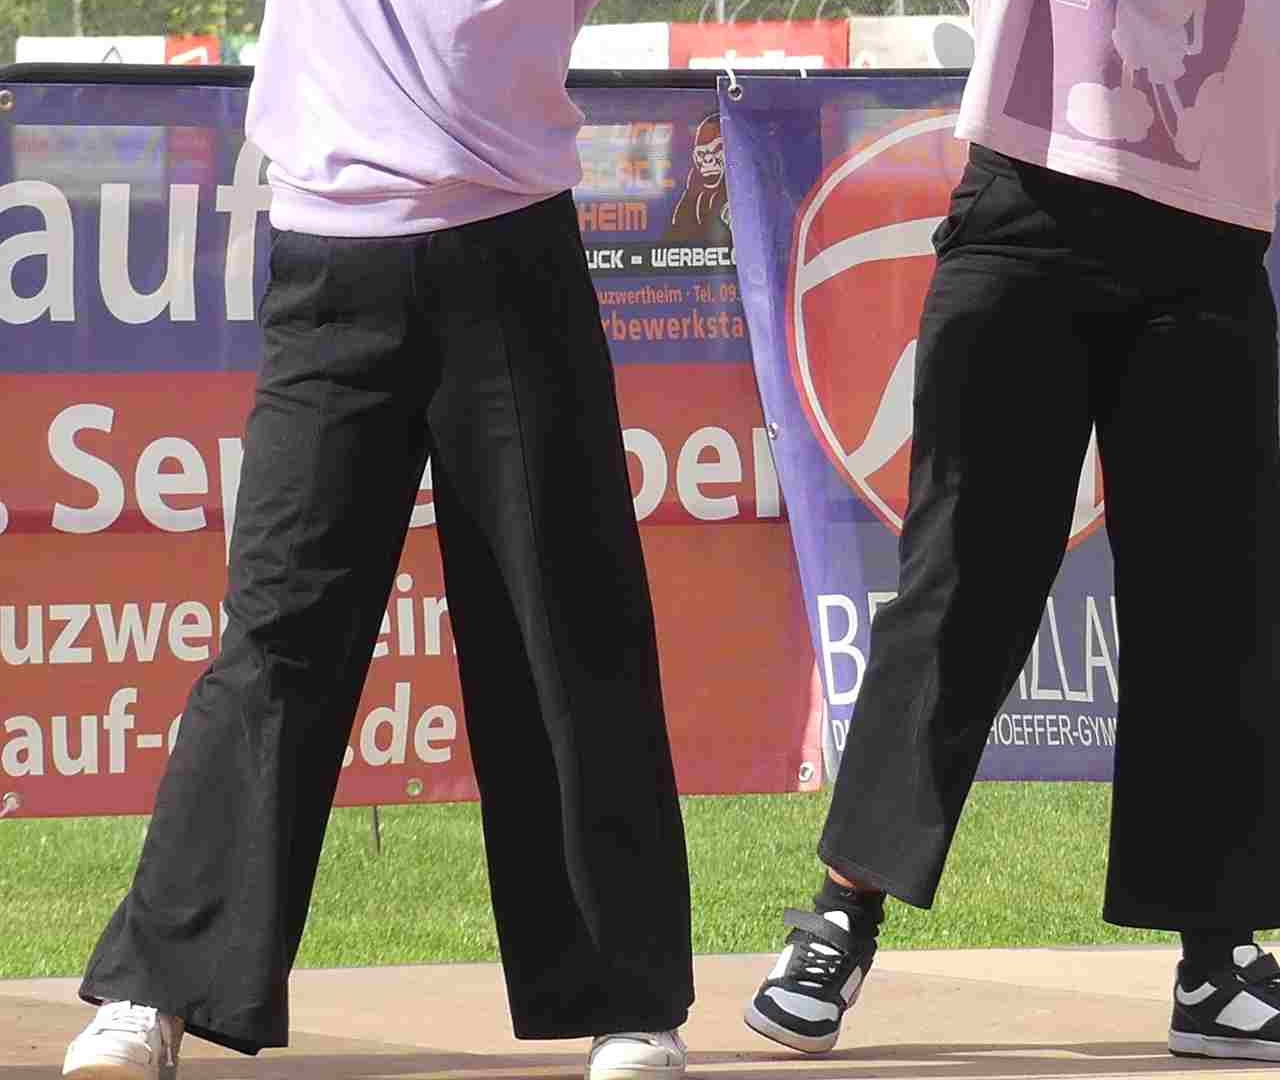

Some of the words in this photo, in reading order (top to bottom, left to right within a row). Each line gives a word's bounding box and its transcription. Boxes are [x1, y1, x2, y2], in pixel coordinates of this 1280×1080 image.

[596, 282, 682, 305] uzwertheim
[719, 282, 738, 304] 09
[601, 309, 745, 341] rbewerksta
